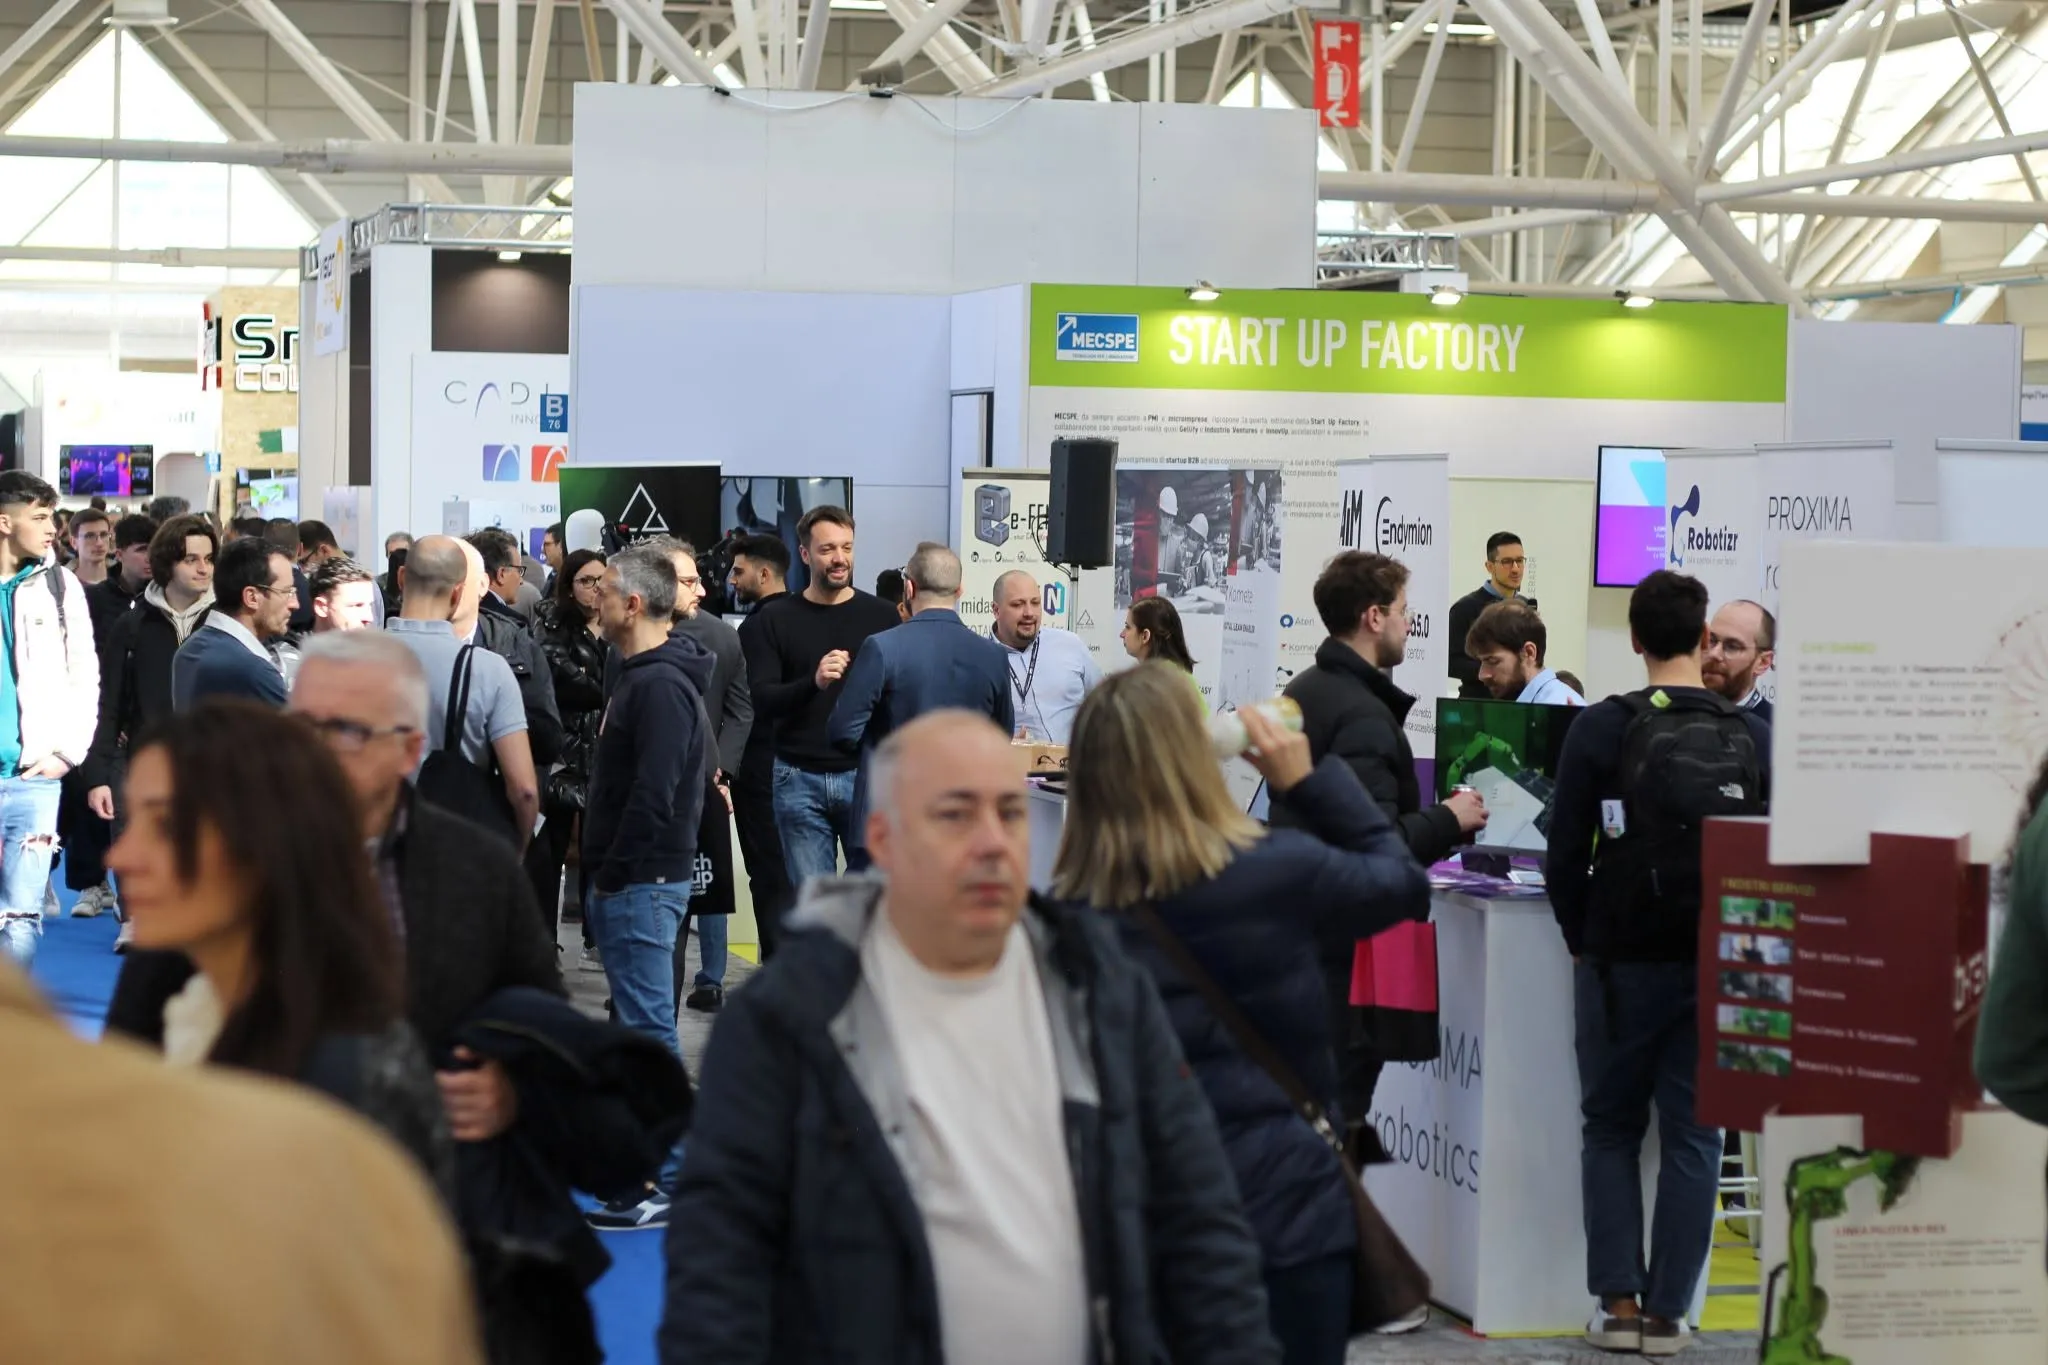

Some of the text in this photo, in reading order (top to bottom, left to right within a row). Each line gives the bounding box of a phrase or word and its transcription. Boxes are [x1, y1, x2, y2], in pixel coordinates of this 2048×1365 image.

[1072, 331, 1136, 349] MECSPE
[1169, 315, 1525, 373] START UP FACTORY
[546, 395, 564, 417] B
[548, 419, 561, 430] 76
[1311, 417, 1325, 425] Start
[1328, 418, 1336, 426] Up
[1768, 495, 1852, 531] PROXIMA
[1381, 514, 1433, 553] Endymion
[1687, 525, 1738, 552] Robotizr
[1374, 1105, 1480, 1194] robotics
